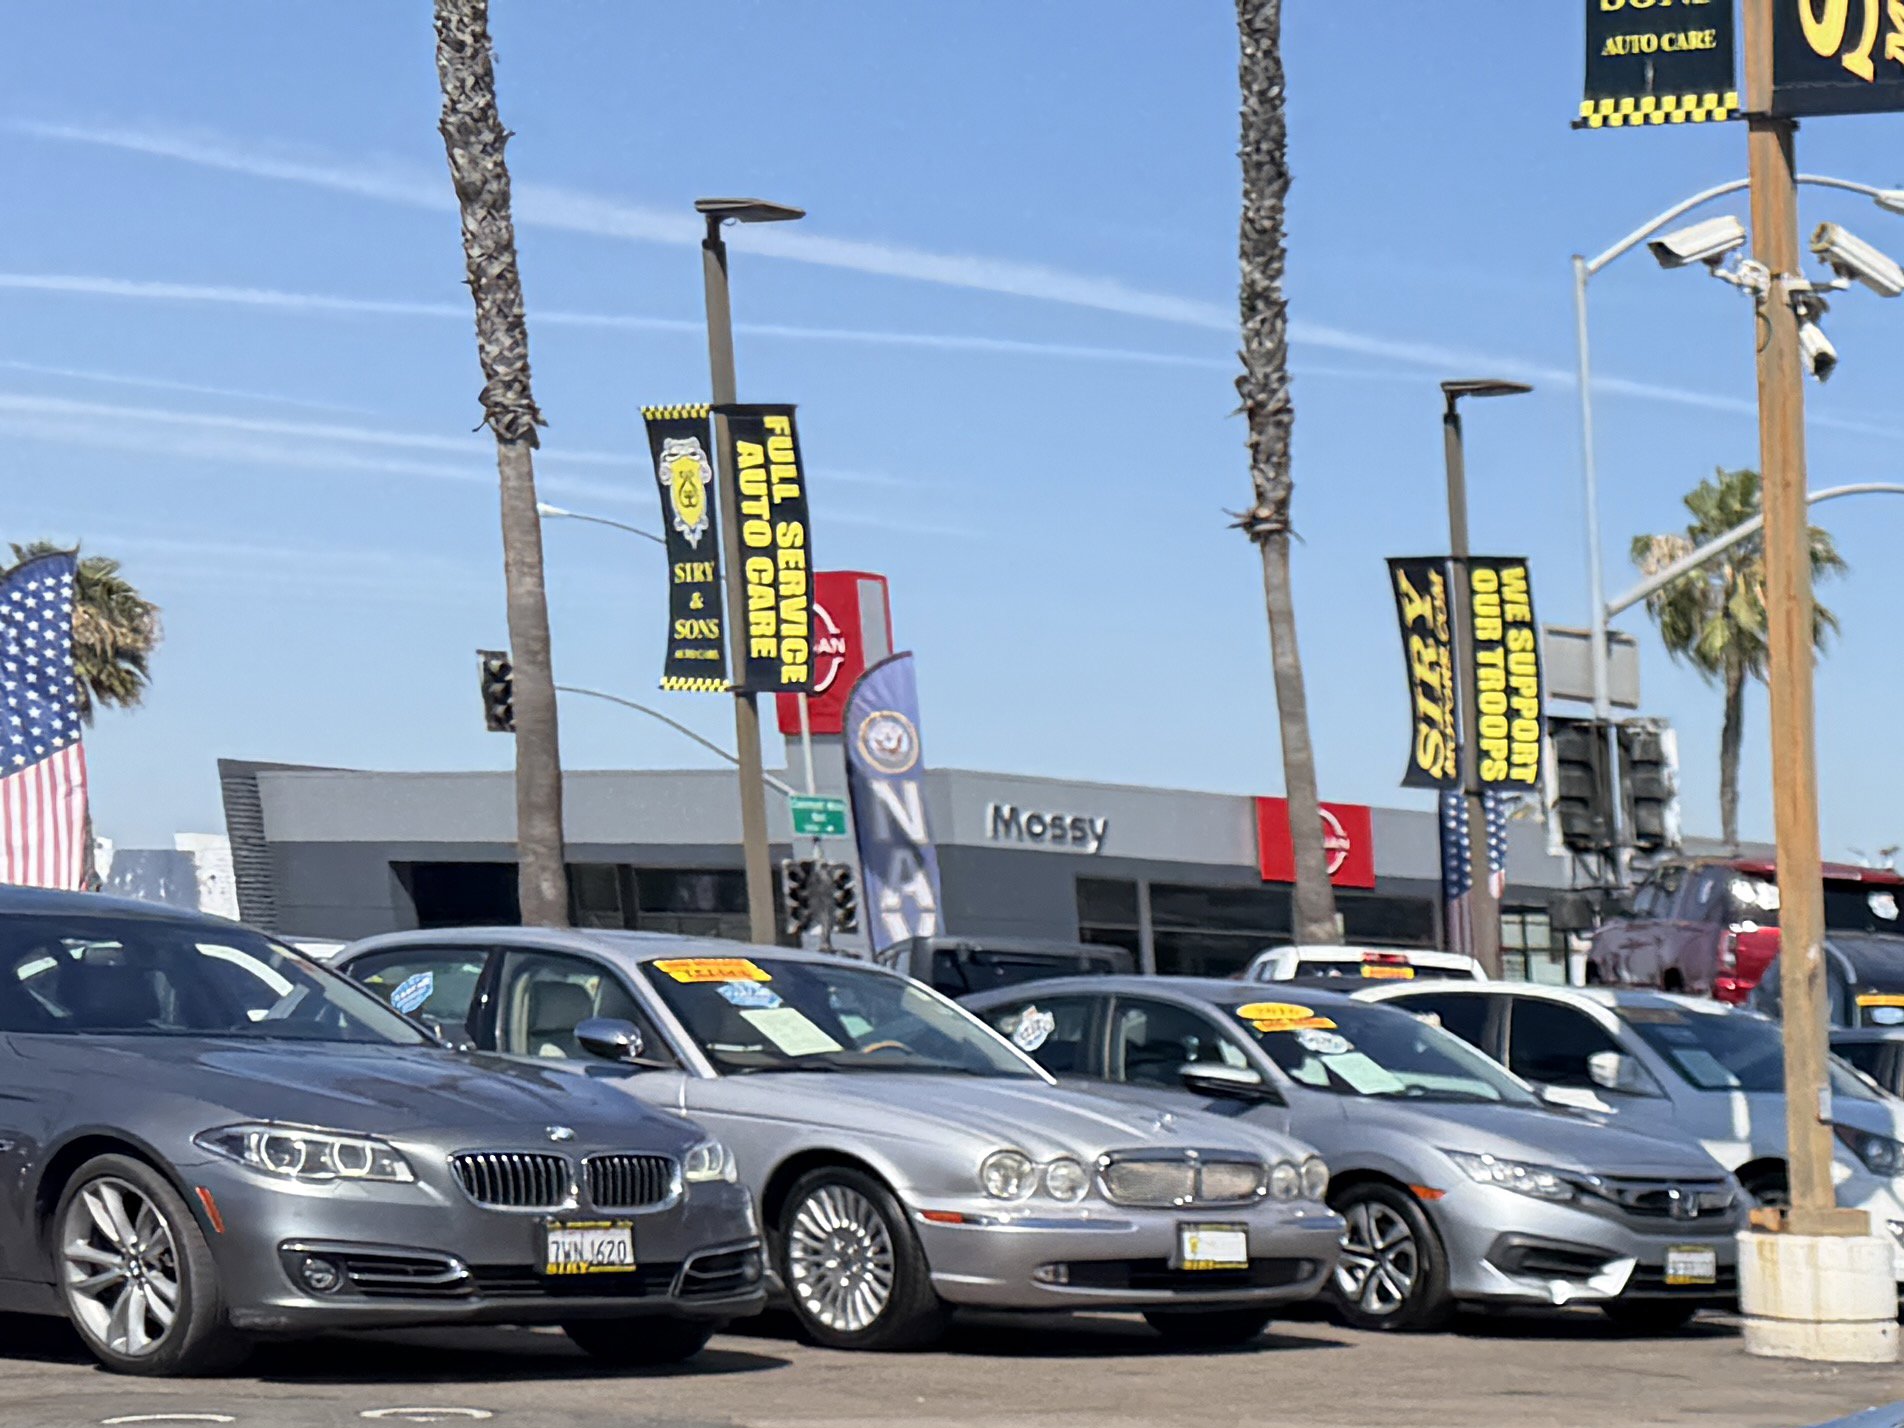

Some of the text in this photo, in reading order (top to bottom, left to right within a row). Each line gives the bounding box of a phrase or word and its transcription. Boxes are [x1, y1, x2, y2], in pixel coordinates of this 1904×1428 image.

[1601, 29, 1717, 55] AUTO CARE
[674, 562, 715, 584] SIRY
[688, 592, 705, 610] &
[736, 440, 777, 659] AUTO CARE
[763, 415, 808, 684] FULL SERVICE
[674, 618, 720, 640] SONS
[1397, 568, 1445, 780] SIRY
[1471, 568, 1509, 782] OUR TROOPS
[1501, 566, 1540, 784] WE SUPPORT
[986, 801, 1109, 854] Mossy
